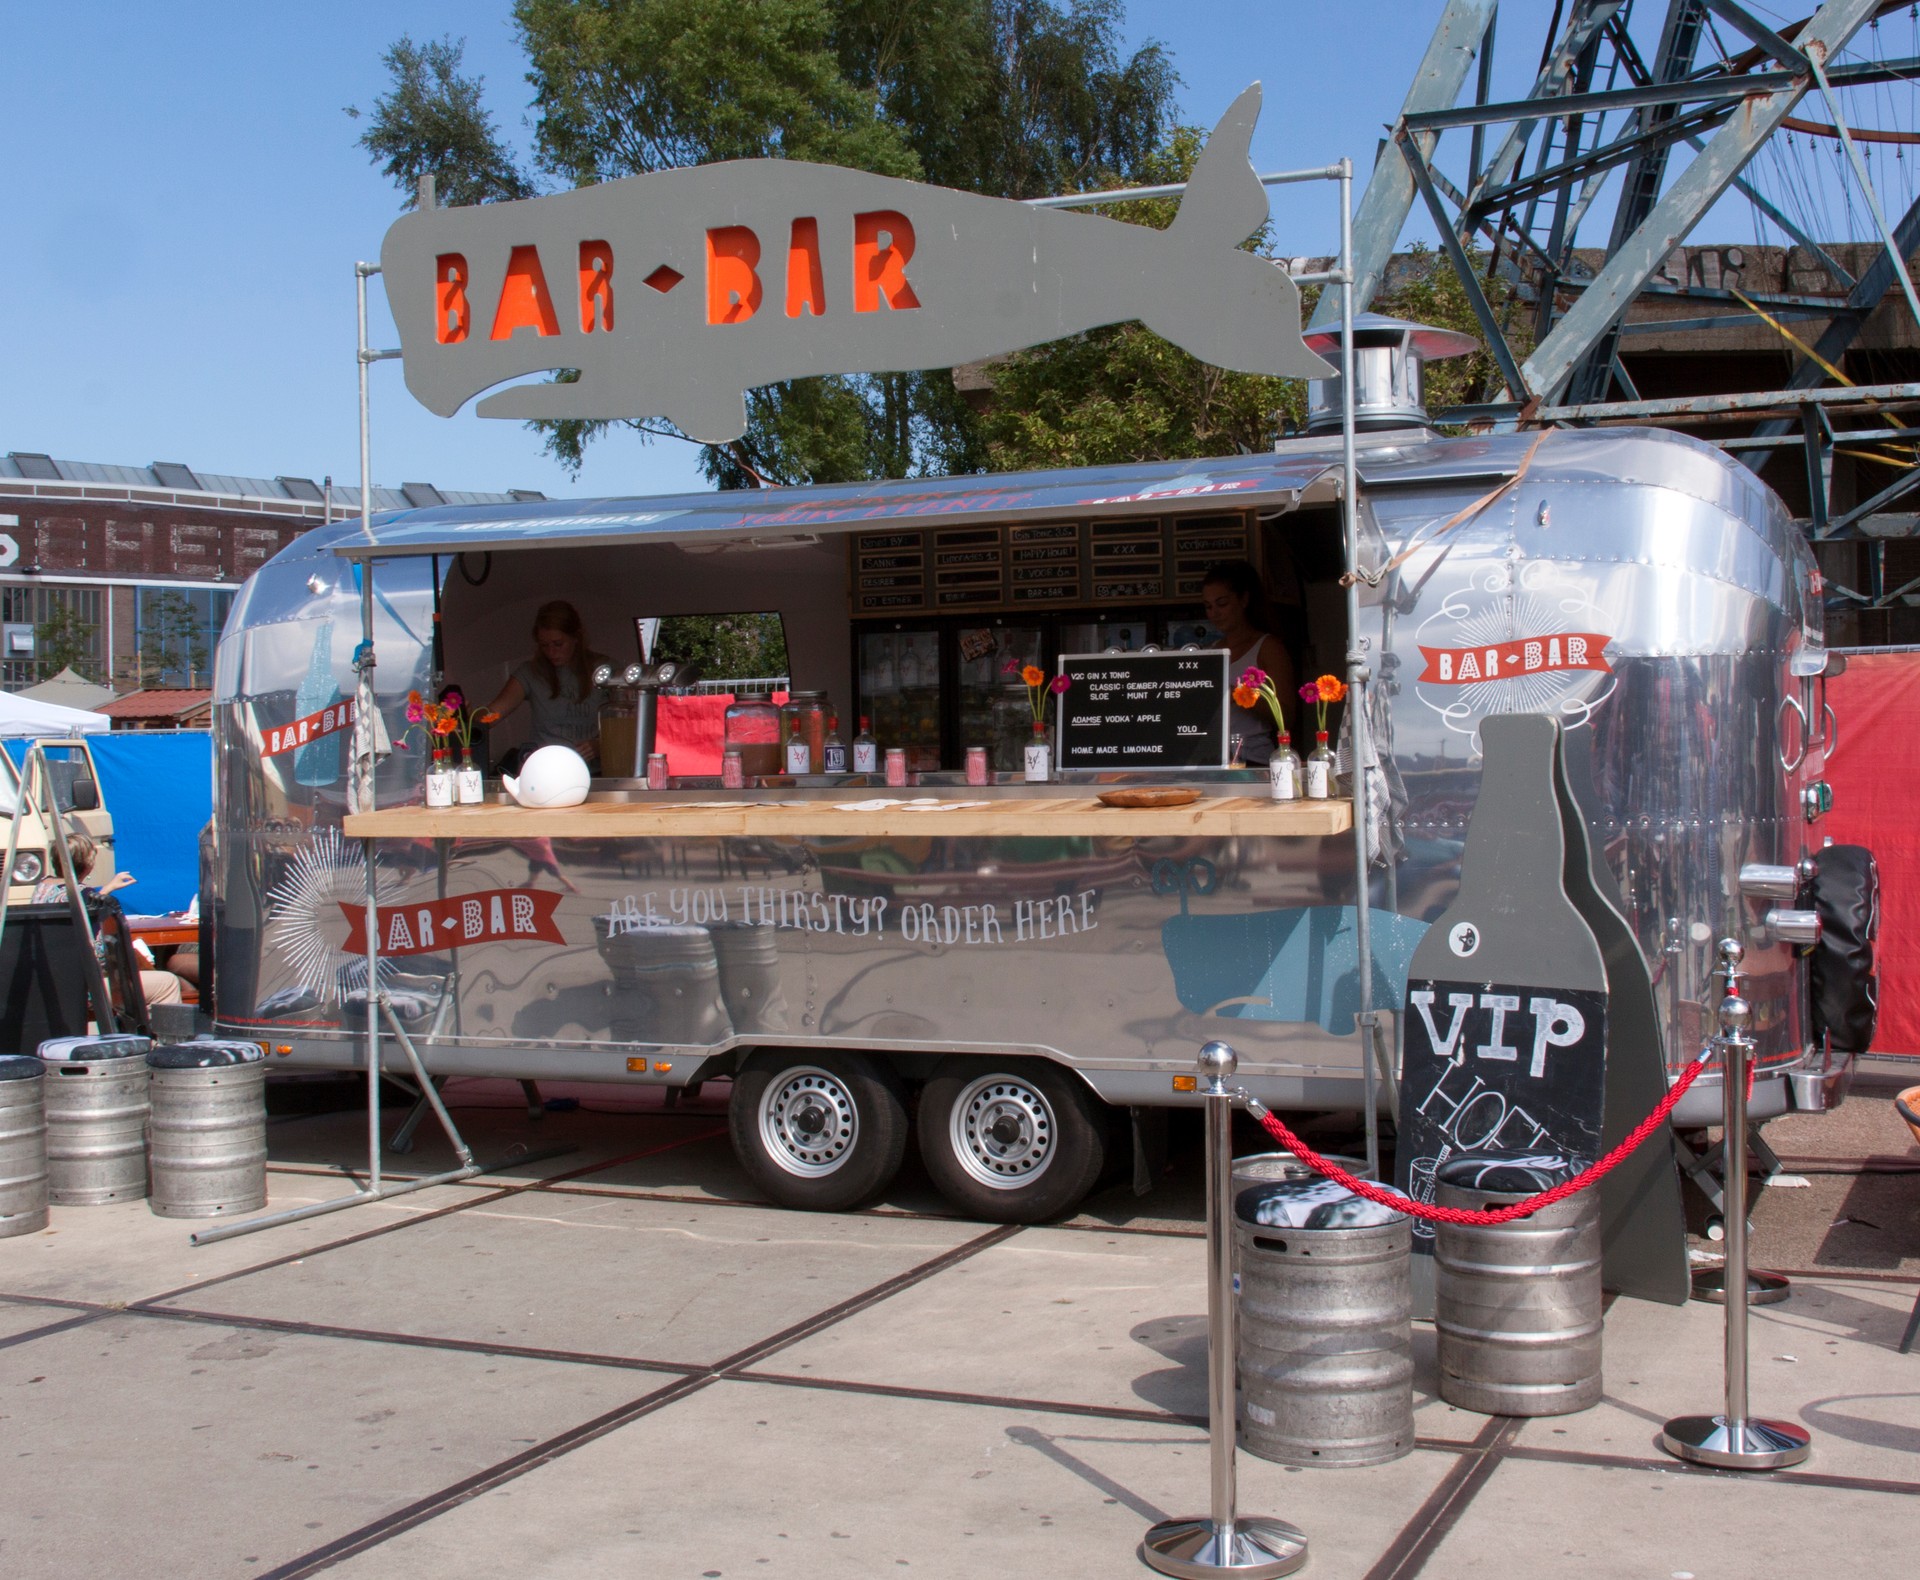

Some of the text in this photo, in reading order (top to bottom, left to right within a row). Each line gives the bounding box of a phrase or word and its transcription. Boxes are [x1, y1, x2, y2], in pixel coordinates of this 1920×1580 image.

[435, 239, 614, 344] BAR
[1440, 637, 1589, 680] BAR BAR
[1101, 672, 1107, 680] X
[1109, 671, 1131, 680] TONIC
[1126, 681, 1158, 690] GEMBER
[1089, 692, 1109, 701] SLOE
[1127, 691, 1149, 699] MUNT
[1164, 691, 1181, 699] BES
[1071, 715, 1102, 724] ADAMSE
[1136, 714, 1162, 722] APPLE
[1177, 725, 1198, 733] YOLO
[1071, 745, 1163, 755] HOME MADE LIMONADE
[462, 894, 538, 939] BAR
[606, 885, 1099, 945] ARE YOU THIRSTY? ORDER HERE
[1410, 990, 1585, 1077] VIP
